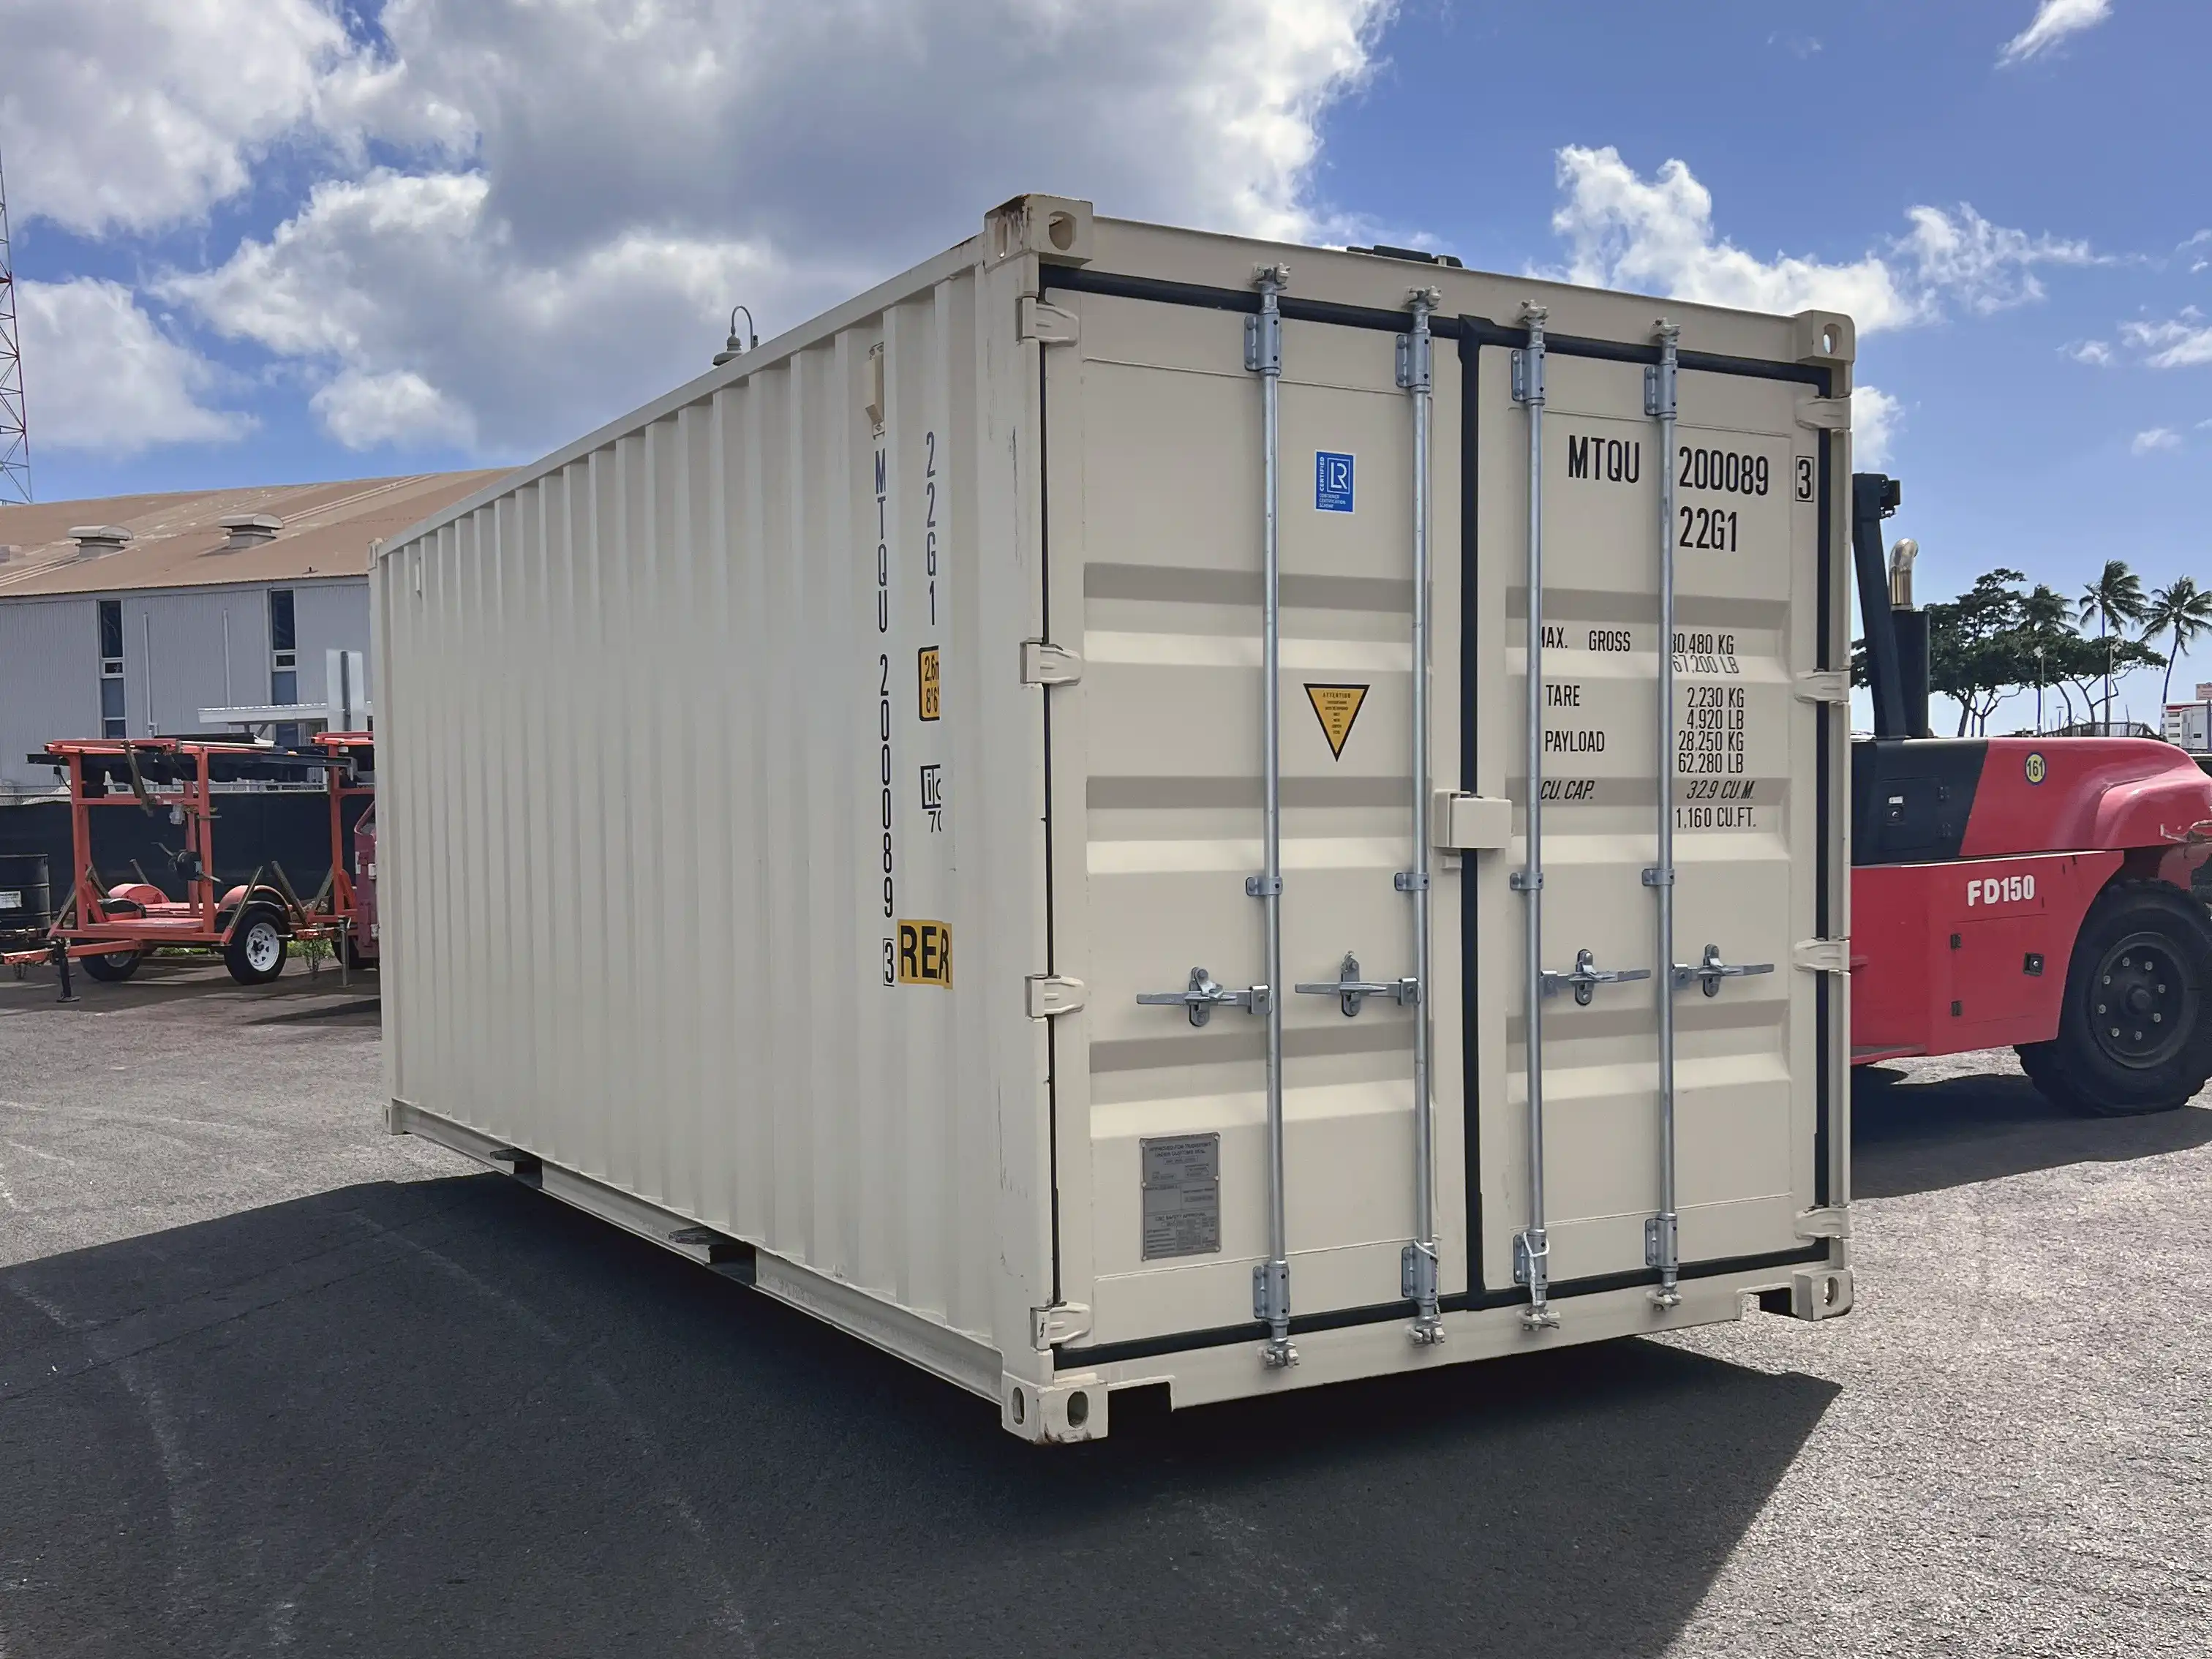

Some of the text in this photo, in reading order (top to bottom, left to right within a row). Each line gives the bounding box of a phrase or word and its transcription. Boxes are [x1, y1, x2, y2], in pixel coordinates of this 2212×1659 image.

[1331, 462, 1347, 489] LR
[1568, 434, 1812, 500] MTQU 200089 3
[926, 431, 936, 626] 22G1
[1679, 505, 1738, 552] 22G1
[1588, 630, 1631, 652] GROSS
[1718, 634, 1734, 655] KG
[1719, 655, 1739, 674] LB
[1546, 685, 1581, 707] TARE
[1728, 687, 1745, 708] KG
[875, 448, 895, 984] MTQU 200089 3
[1728, 709, 1744, 730] LB
[1545, 730, 1606, 752] PAYLOAD
[1728, 731, 1745, 752] KG
[1728, 753, 1744, 774] LB
[2027, 759, 2044, 777] 161
[1540, 780, 1562, 800] CU.
[1564, 780, 1595, 800] CAP.
[1676, 807, 1712, 829] 1,160
[1967, 873, 2035, 907] FD150
